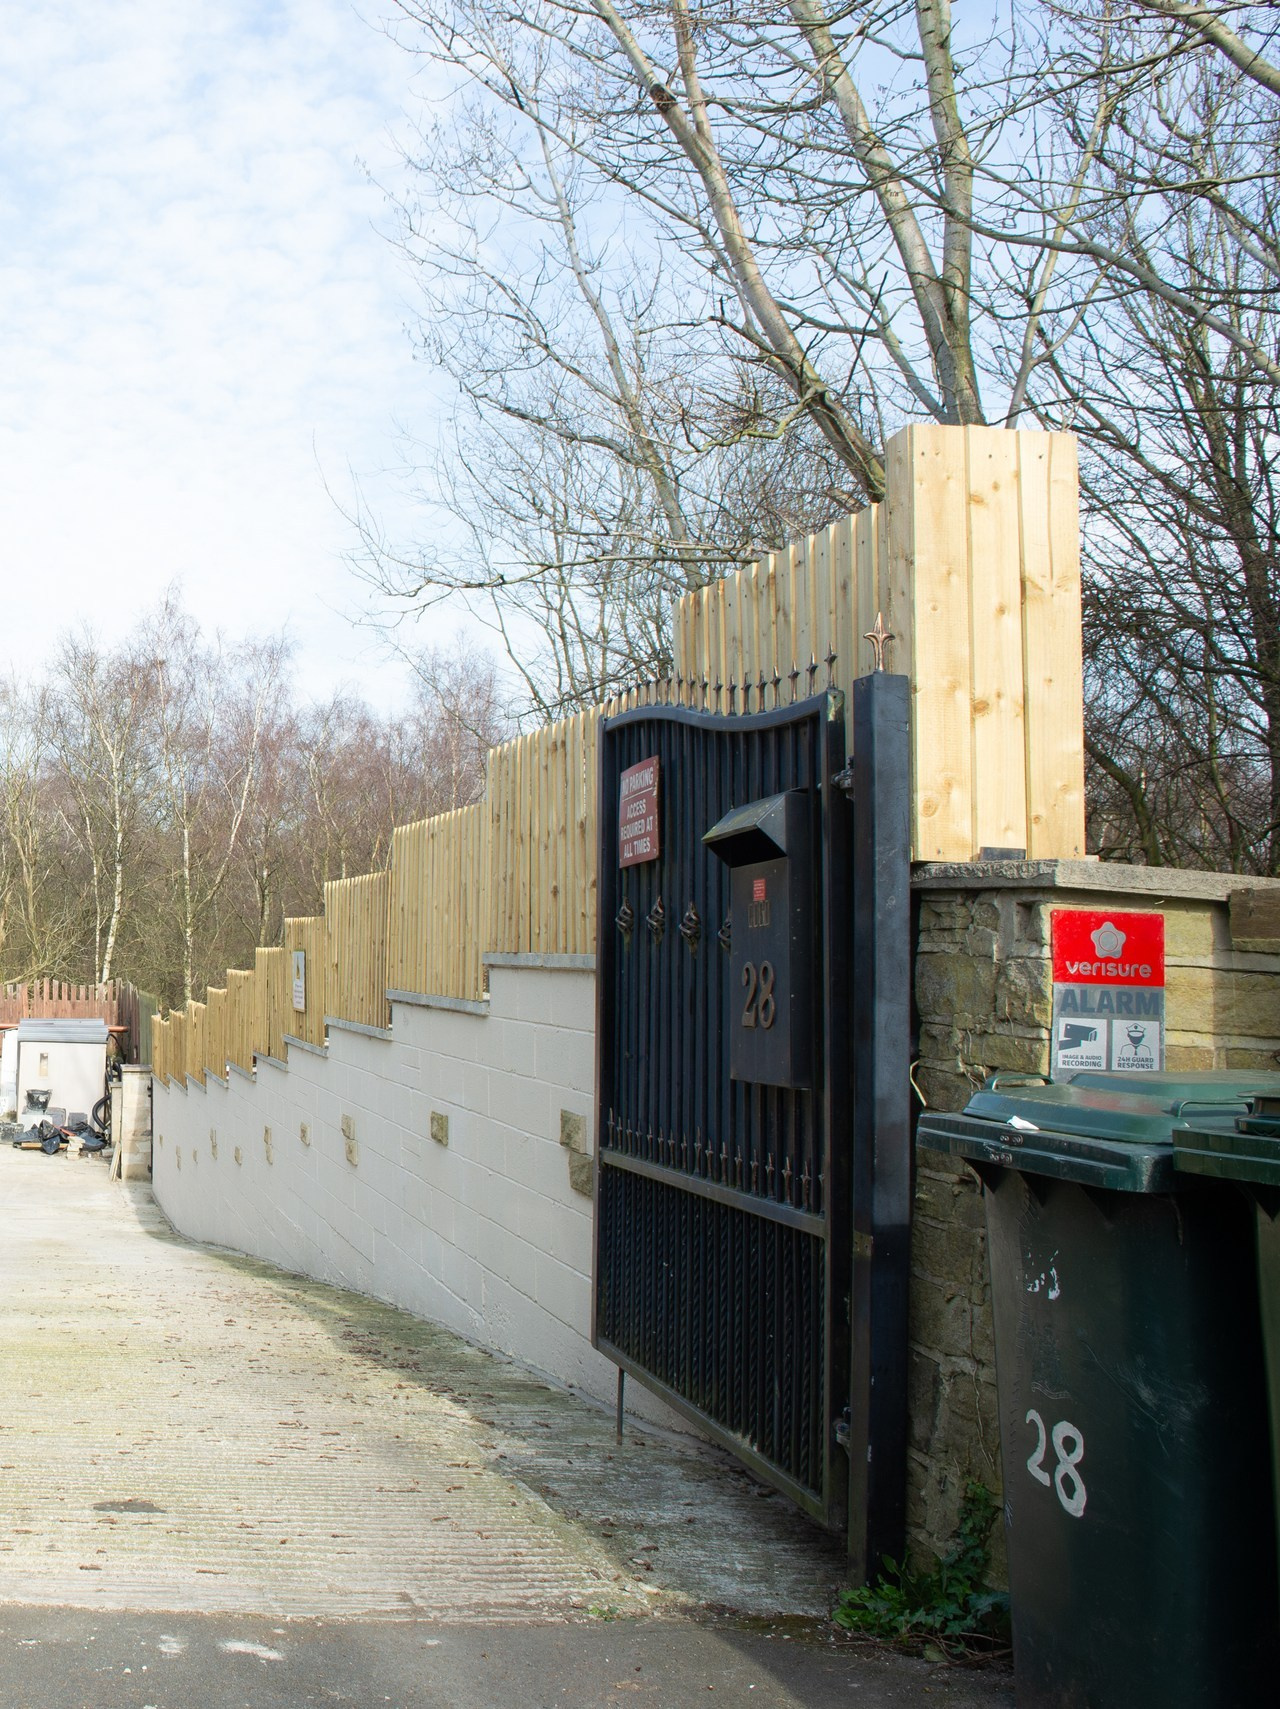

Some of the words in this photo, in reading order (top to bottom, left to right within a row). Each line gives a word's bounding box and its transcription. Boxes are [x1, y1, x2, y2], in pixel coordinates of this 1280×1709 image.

[621, 777, 629, 797] NO
[630, 766, 654, 790] PARKING
[627, 798, 647, 820] ACCESS
[621, 819, 645, 841] REQUIRED
[646, 816, 654, 832] AT
[624, 841, 633, 859] ALL
[634, 837, 651, 856] TIMES
[1065, 961, 1152, 978] verisure
[741, 960, 776, 1030] 28
[1060, 988, 1160, 1016] ALARM
[1026, 1409, 1087, 1518] 28
